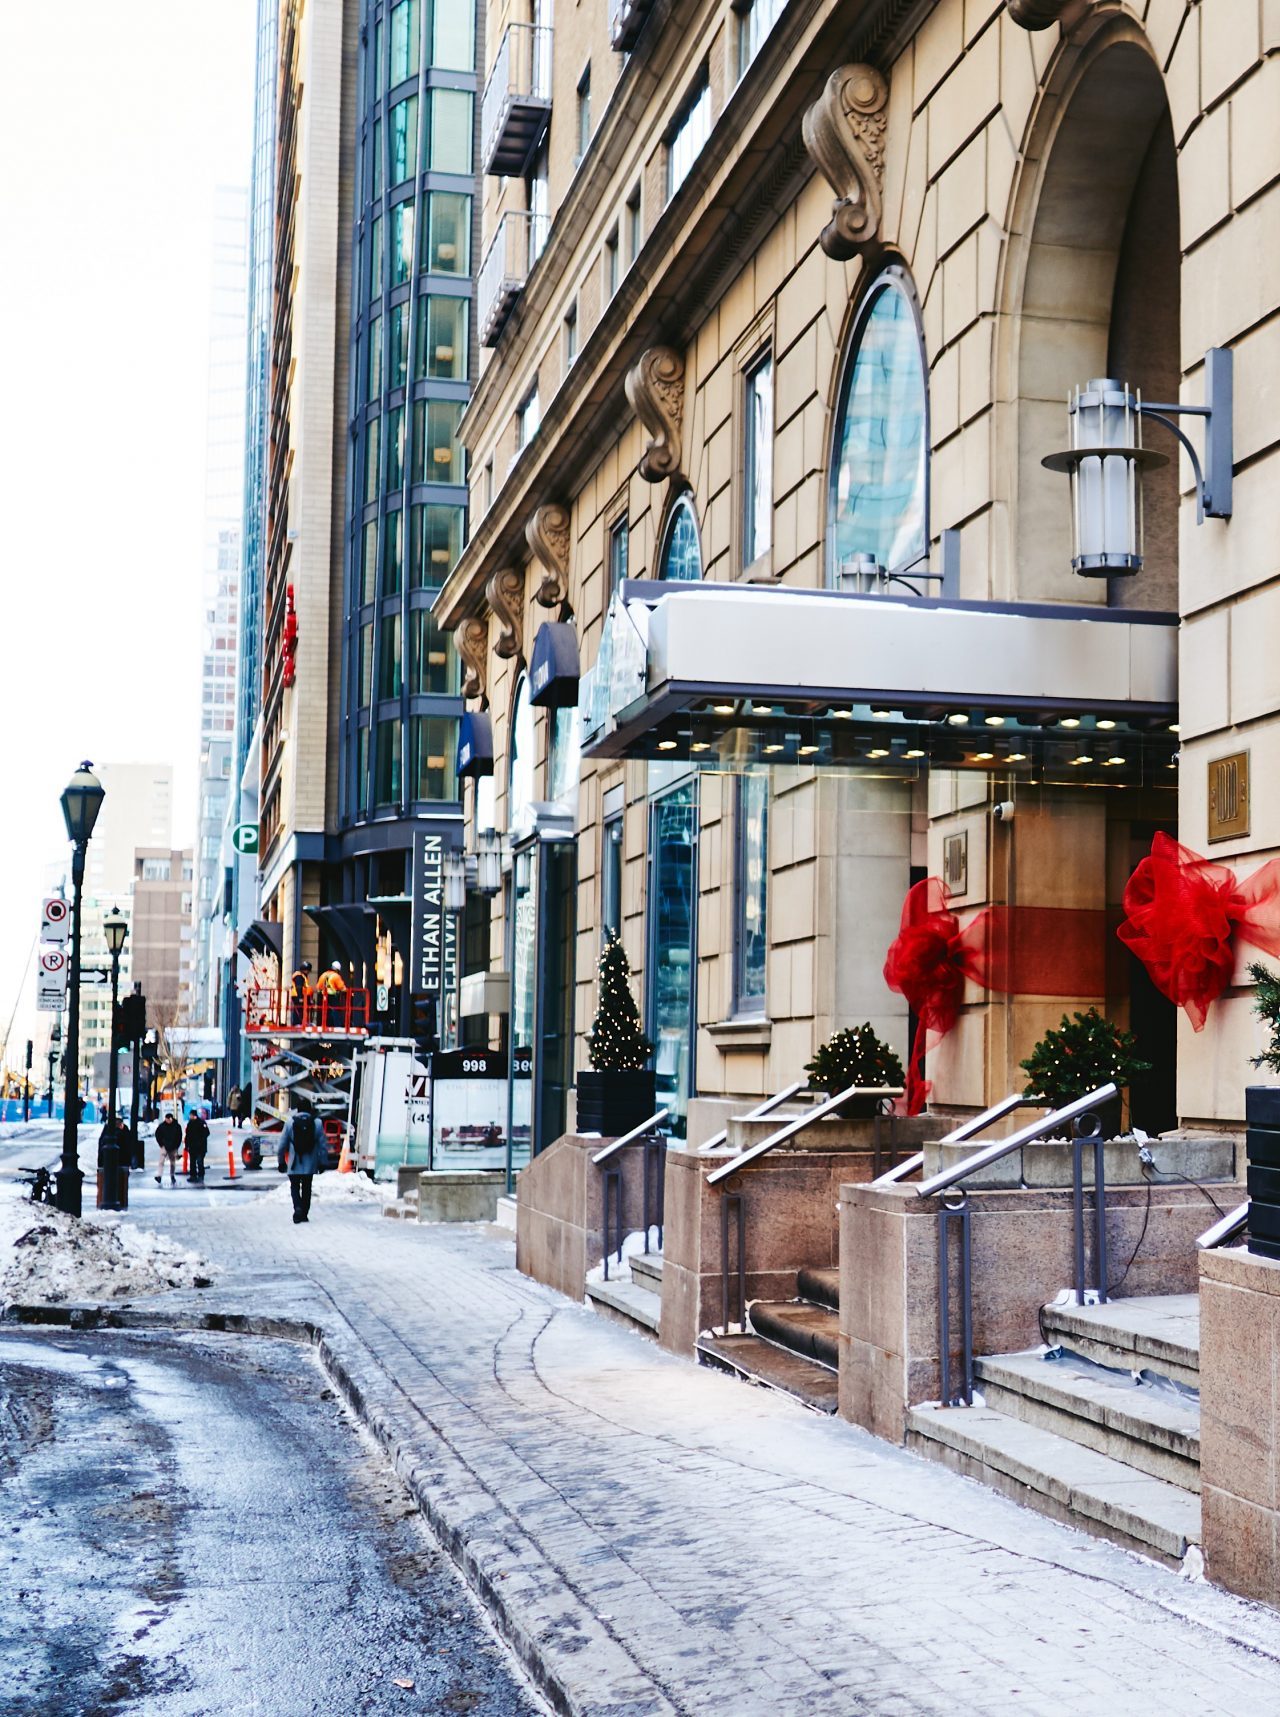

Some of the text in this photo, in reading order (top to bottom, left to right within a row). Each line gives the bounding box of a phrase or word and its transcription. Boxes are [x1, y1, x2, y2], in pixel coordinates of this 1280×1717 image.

[239, 827, 257, 850] P
[422, 835, 442, 989] ETHAN ALLEN
[462, 1060, 487, 1072] 998
